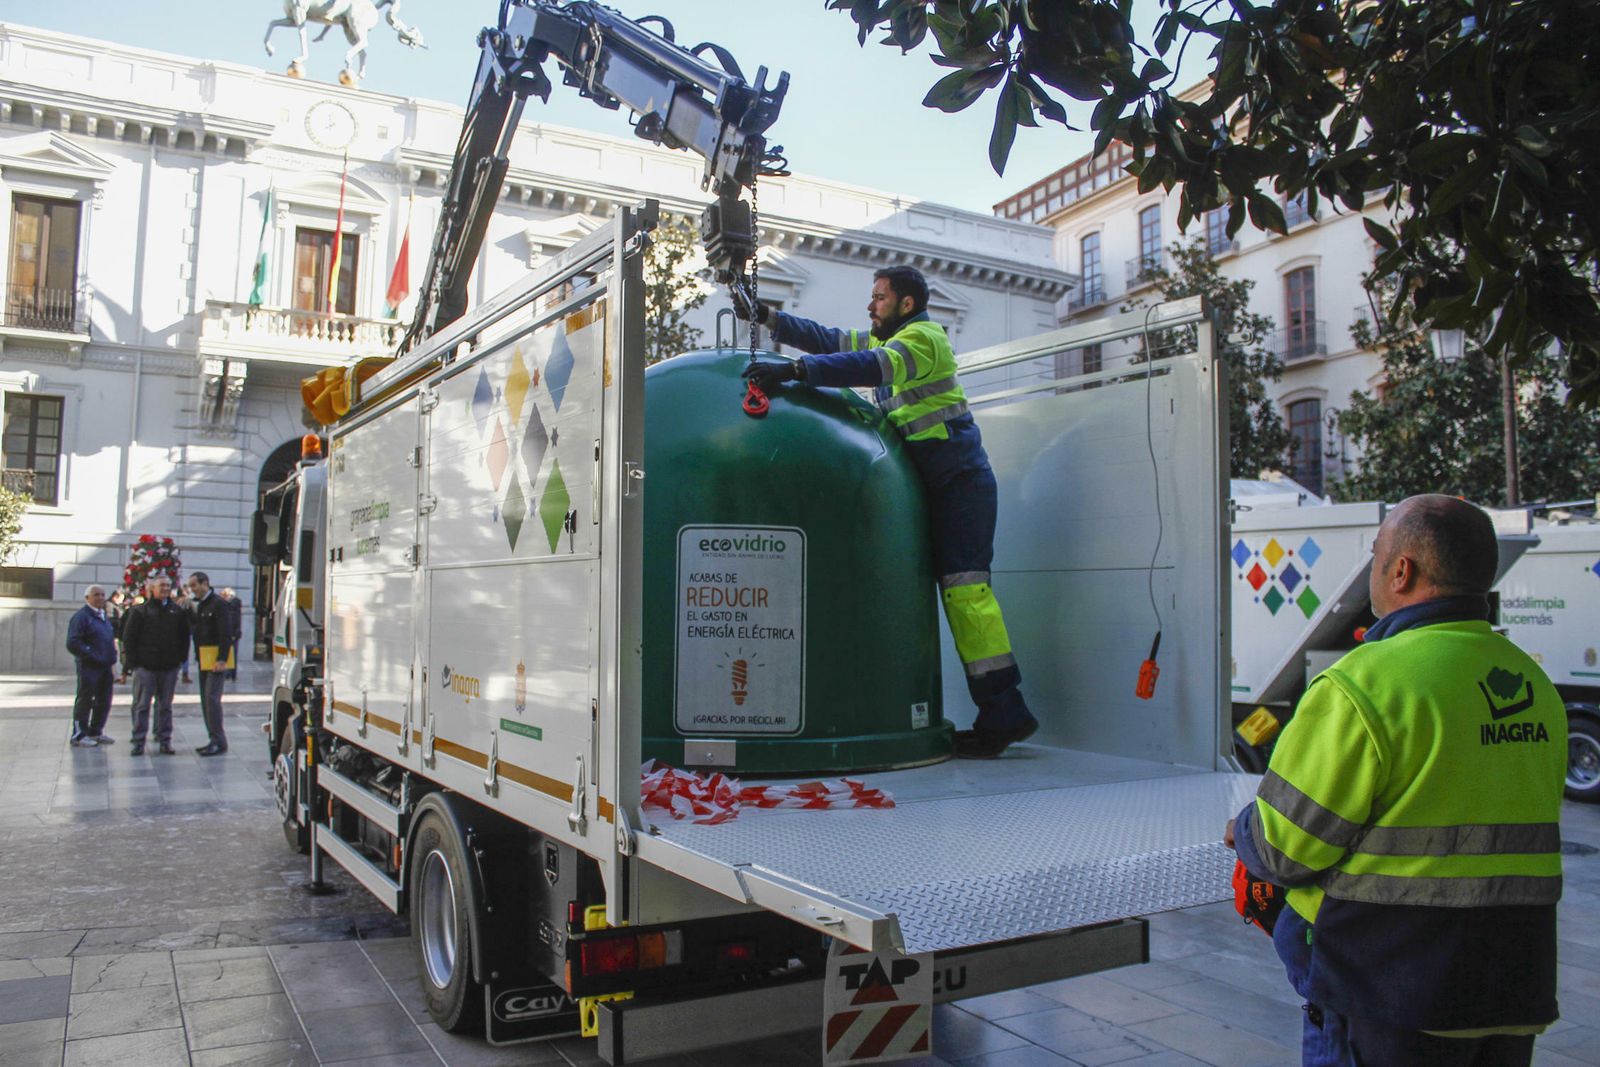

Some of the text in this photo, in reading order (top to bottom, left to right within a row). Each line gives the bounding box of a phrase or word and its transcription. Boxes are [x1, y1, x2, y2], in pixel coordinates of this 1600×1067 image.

[699, 533, 786, 553] ecovidrio
[689, 573, 738, 584] ACABAS DE
[687, 587, 769, 608] REDUCIR
[687, 611, 748, 622] EL GASTO EN
[688, 623, 795, 640] ENERGÍA ELÉCTRICA
[451, 667, 480, 704] inagra
[693, 715, 787, 726] ¡GRACIAS POR RECICLAR!
[1480, 722, 1549, 746] INAGRA
[839, 956, 920, 993] TAP
